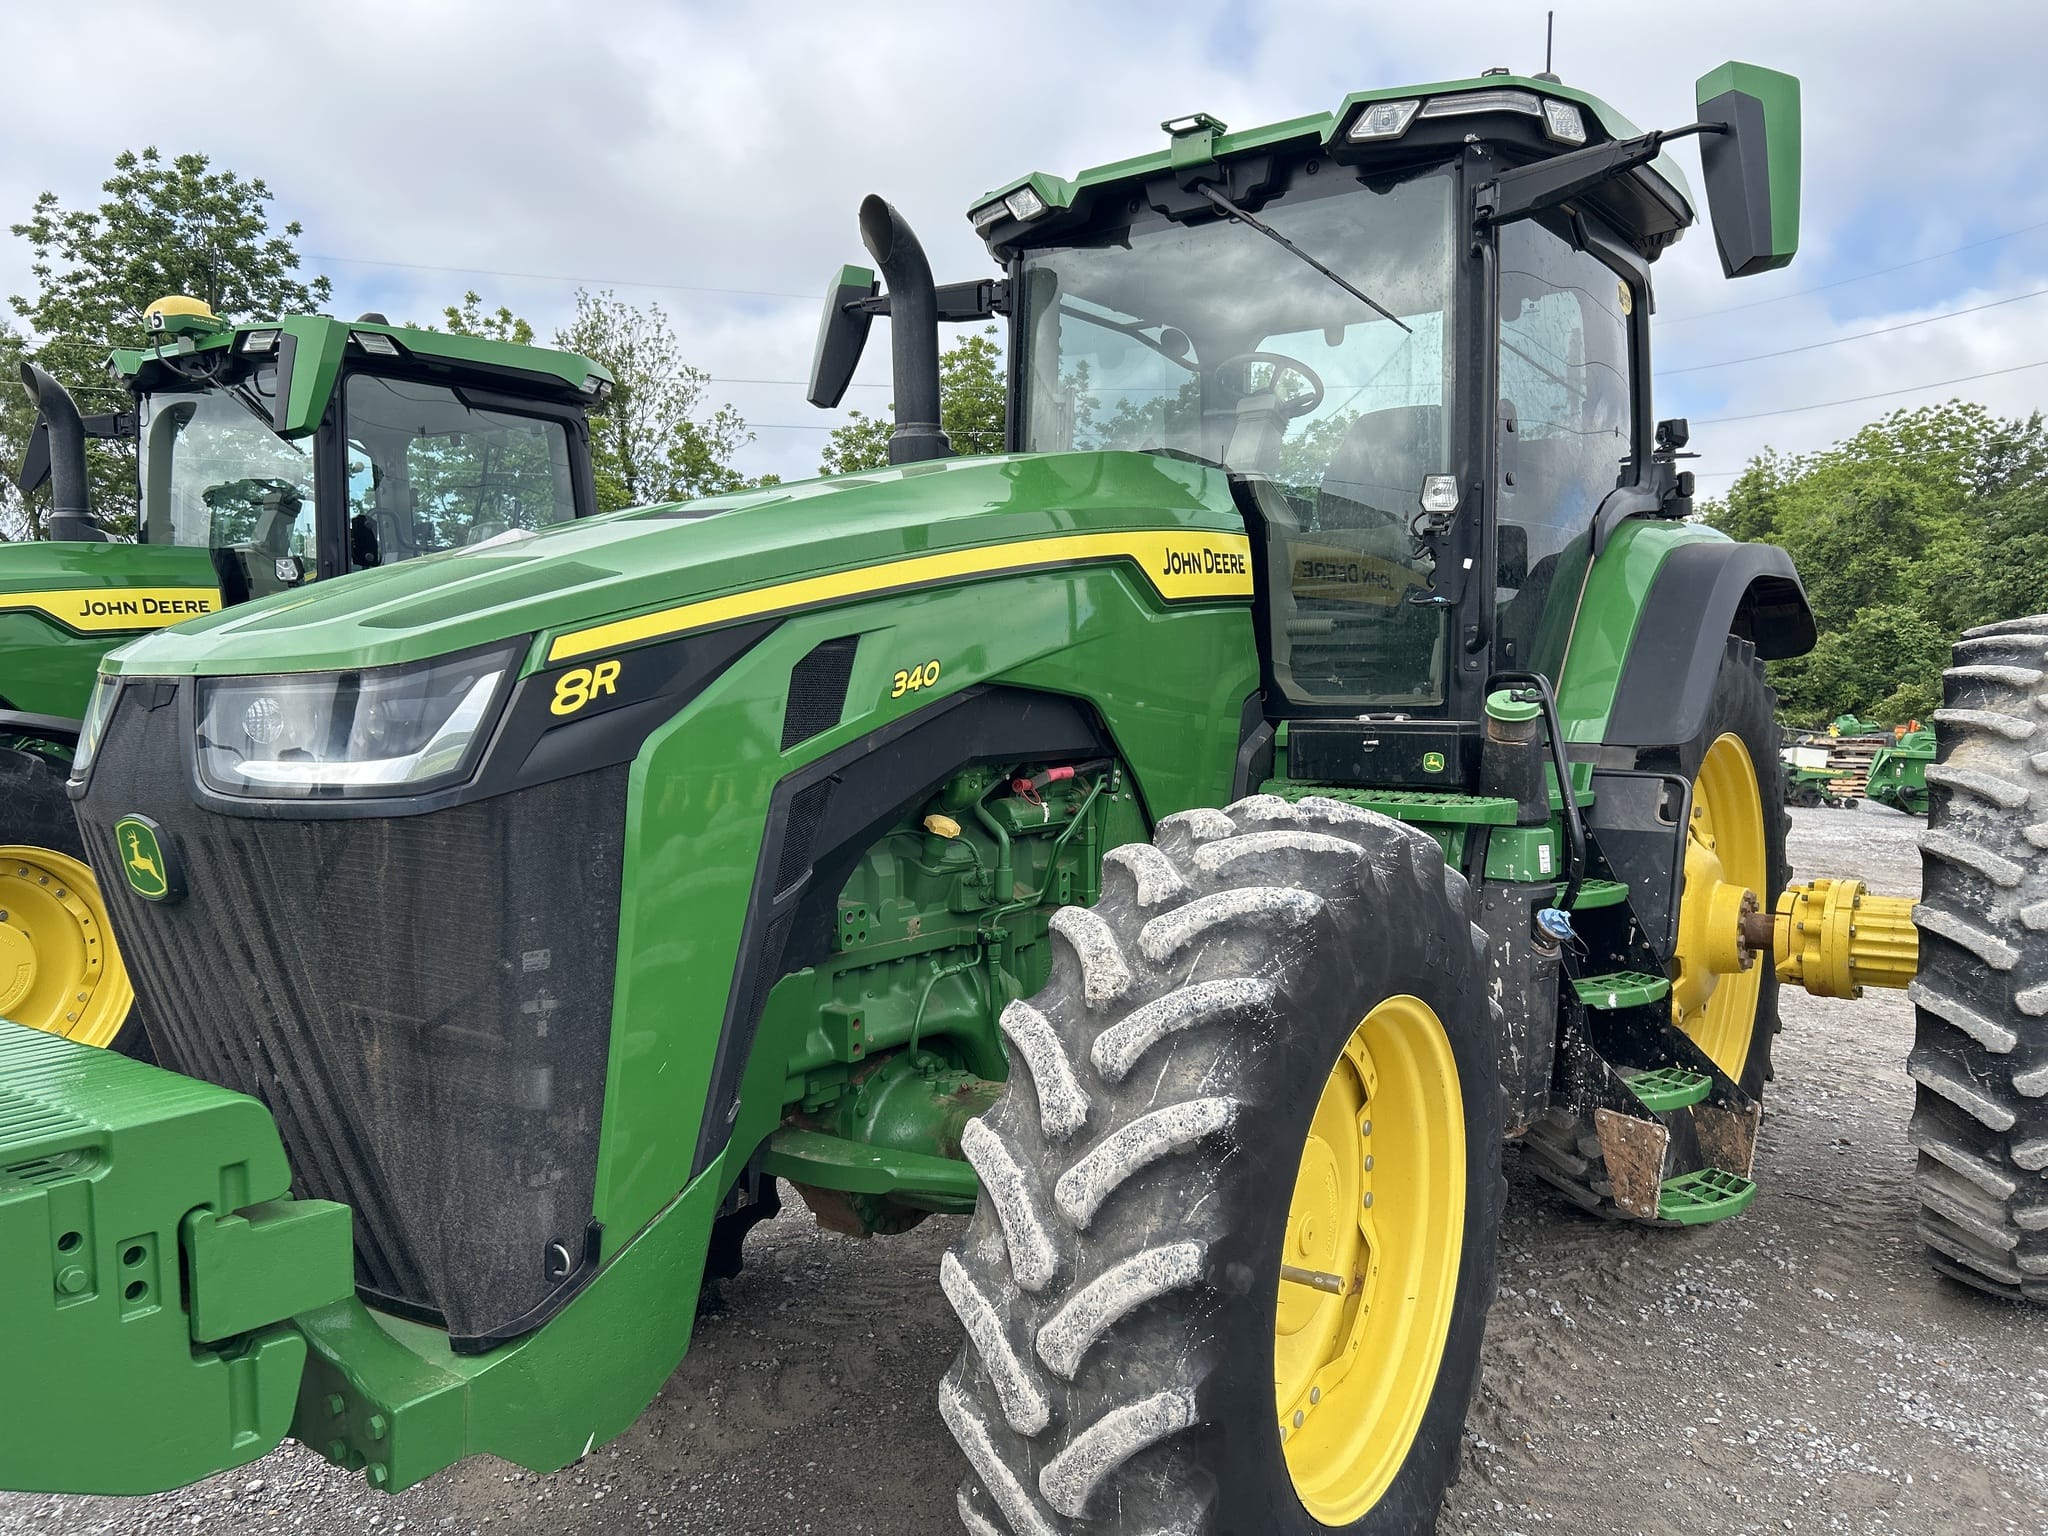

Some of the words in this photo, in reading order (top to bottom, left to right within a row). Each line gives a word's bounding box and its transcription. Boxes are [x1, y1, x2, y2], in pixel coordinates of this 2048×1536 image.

[153, 311, 163, 329] 5
[1163, 547, 1202, 575] JOHN
[1203, 548, 1246, 574] DEERE
[80, 599, 138, 616] JOHN
[142, 598, 211, 614] DEERE
[550, 660, 621, 716] 8R
[891, 659, 941, 699] 340
